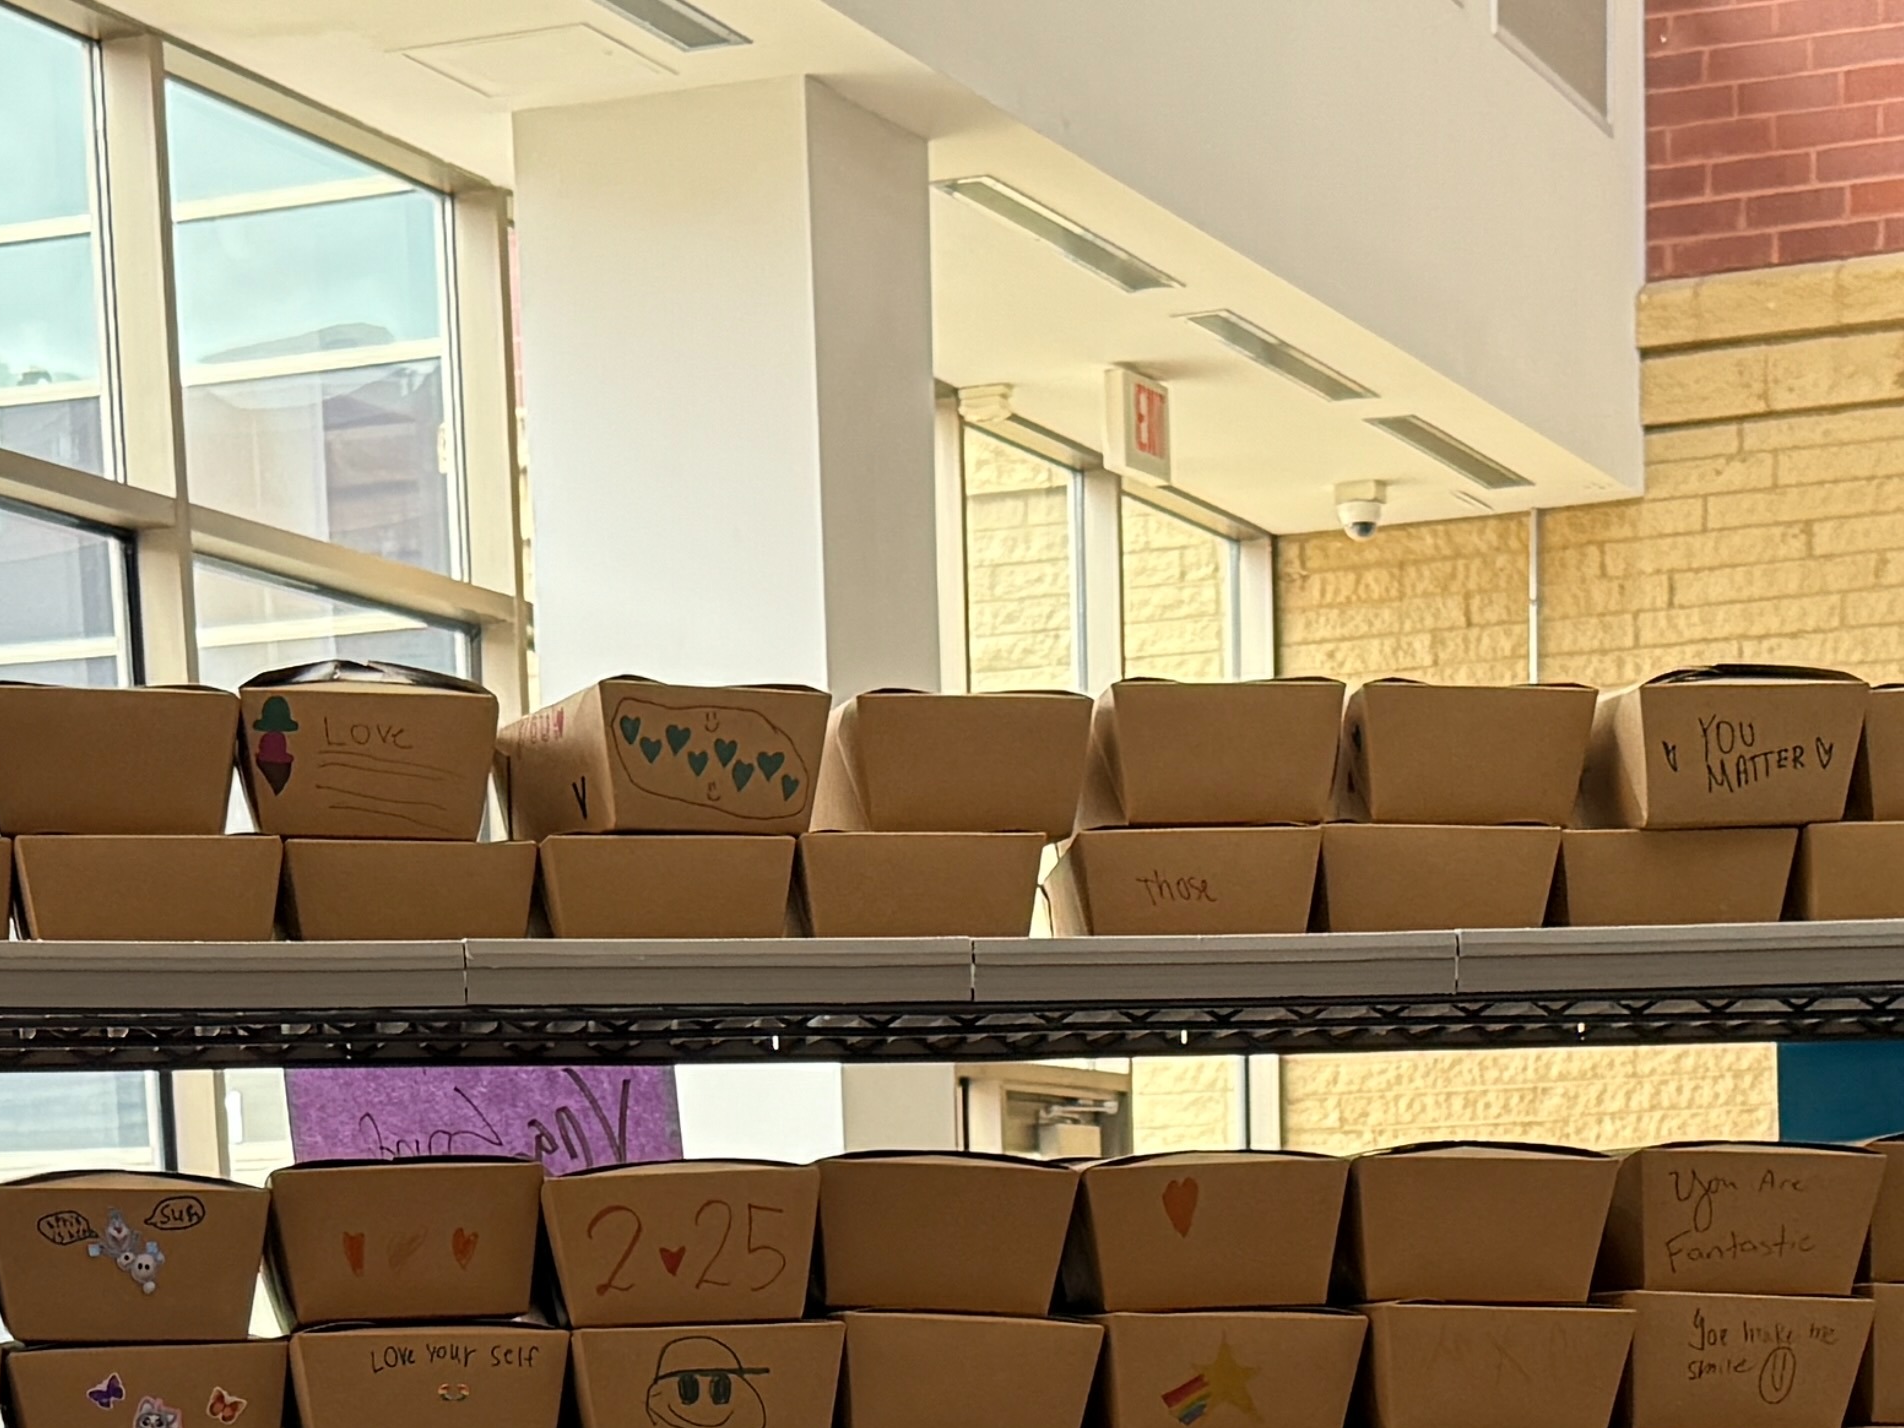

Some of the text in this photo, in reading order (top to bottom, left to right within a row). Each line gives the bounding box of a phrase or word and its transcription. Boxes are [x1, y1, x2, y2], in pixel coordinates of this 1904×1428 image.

[1697, 711, 1756, 758] YOU
[1705, 742, 1807, 795] MATTER
[1664, 1223, 1818, 1275] Fantastic
